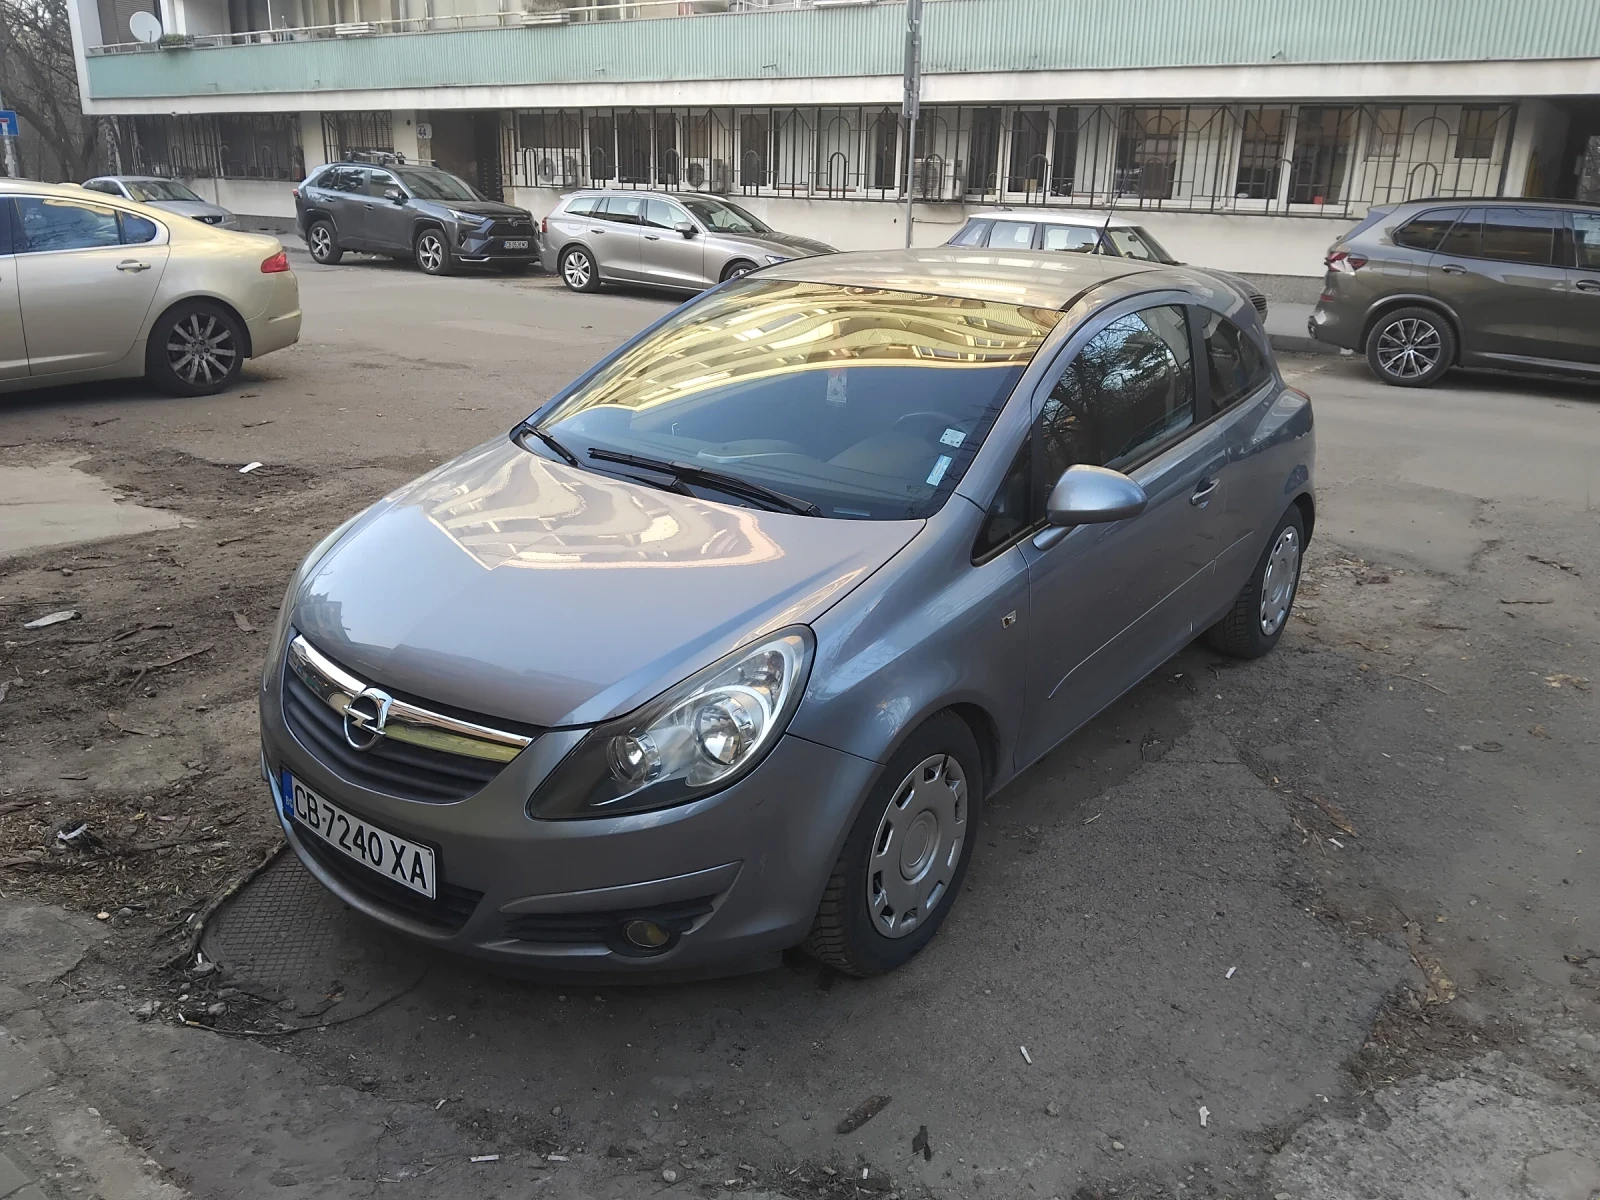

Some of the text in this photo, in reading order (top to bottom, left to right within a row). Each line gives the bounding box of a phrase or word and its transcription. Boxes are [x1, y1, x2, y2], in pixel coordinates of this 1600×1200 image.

[285, 795, 294, 809] BG
[295, 784, 428, 890] CB 7240 XA
